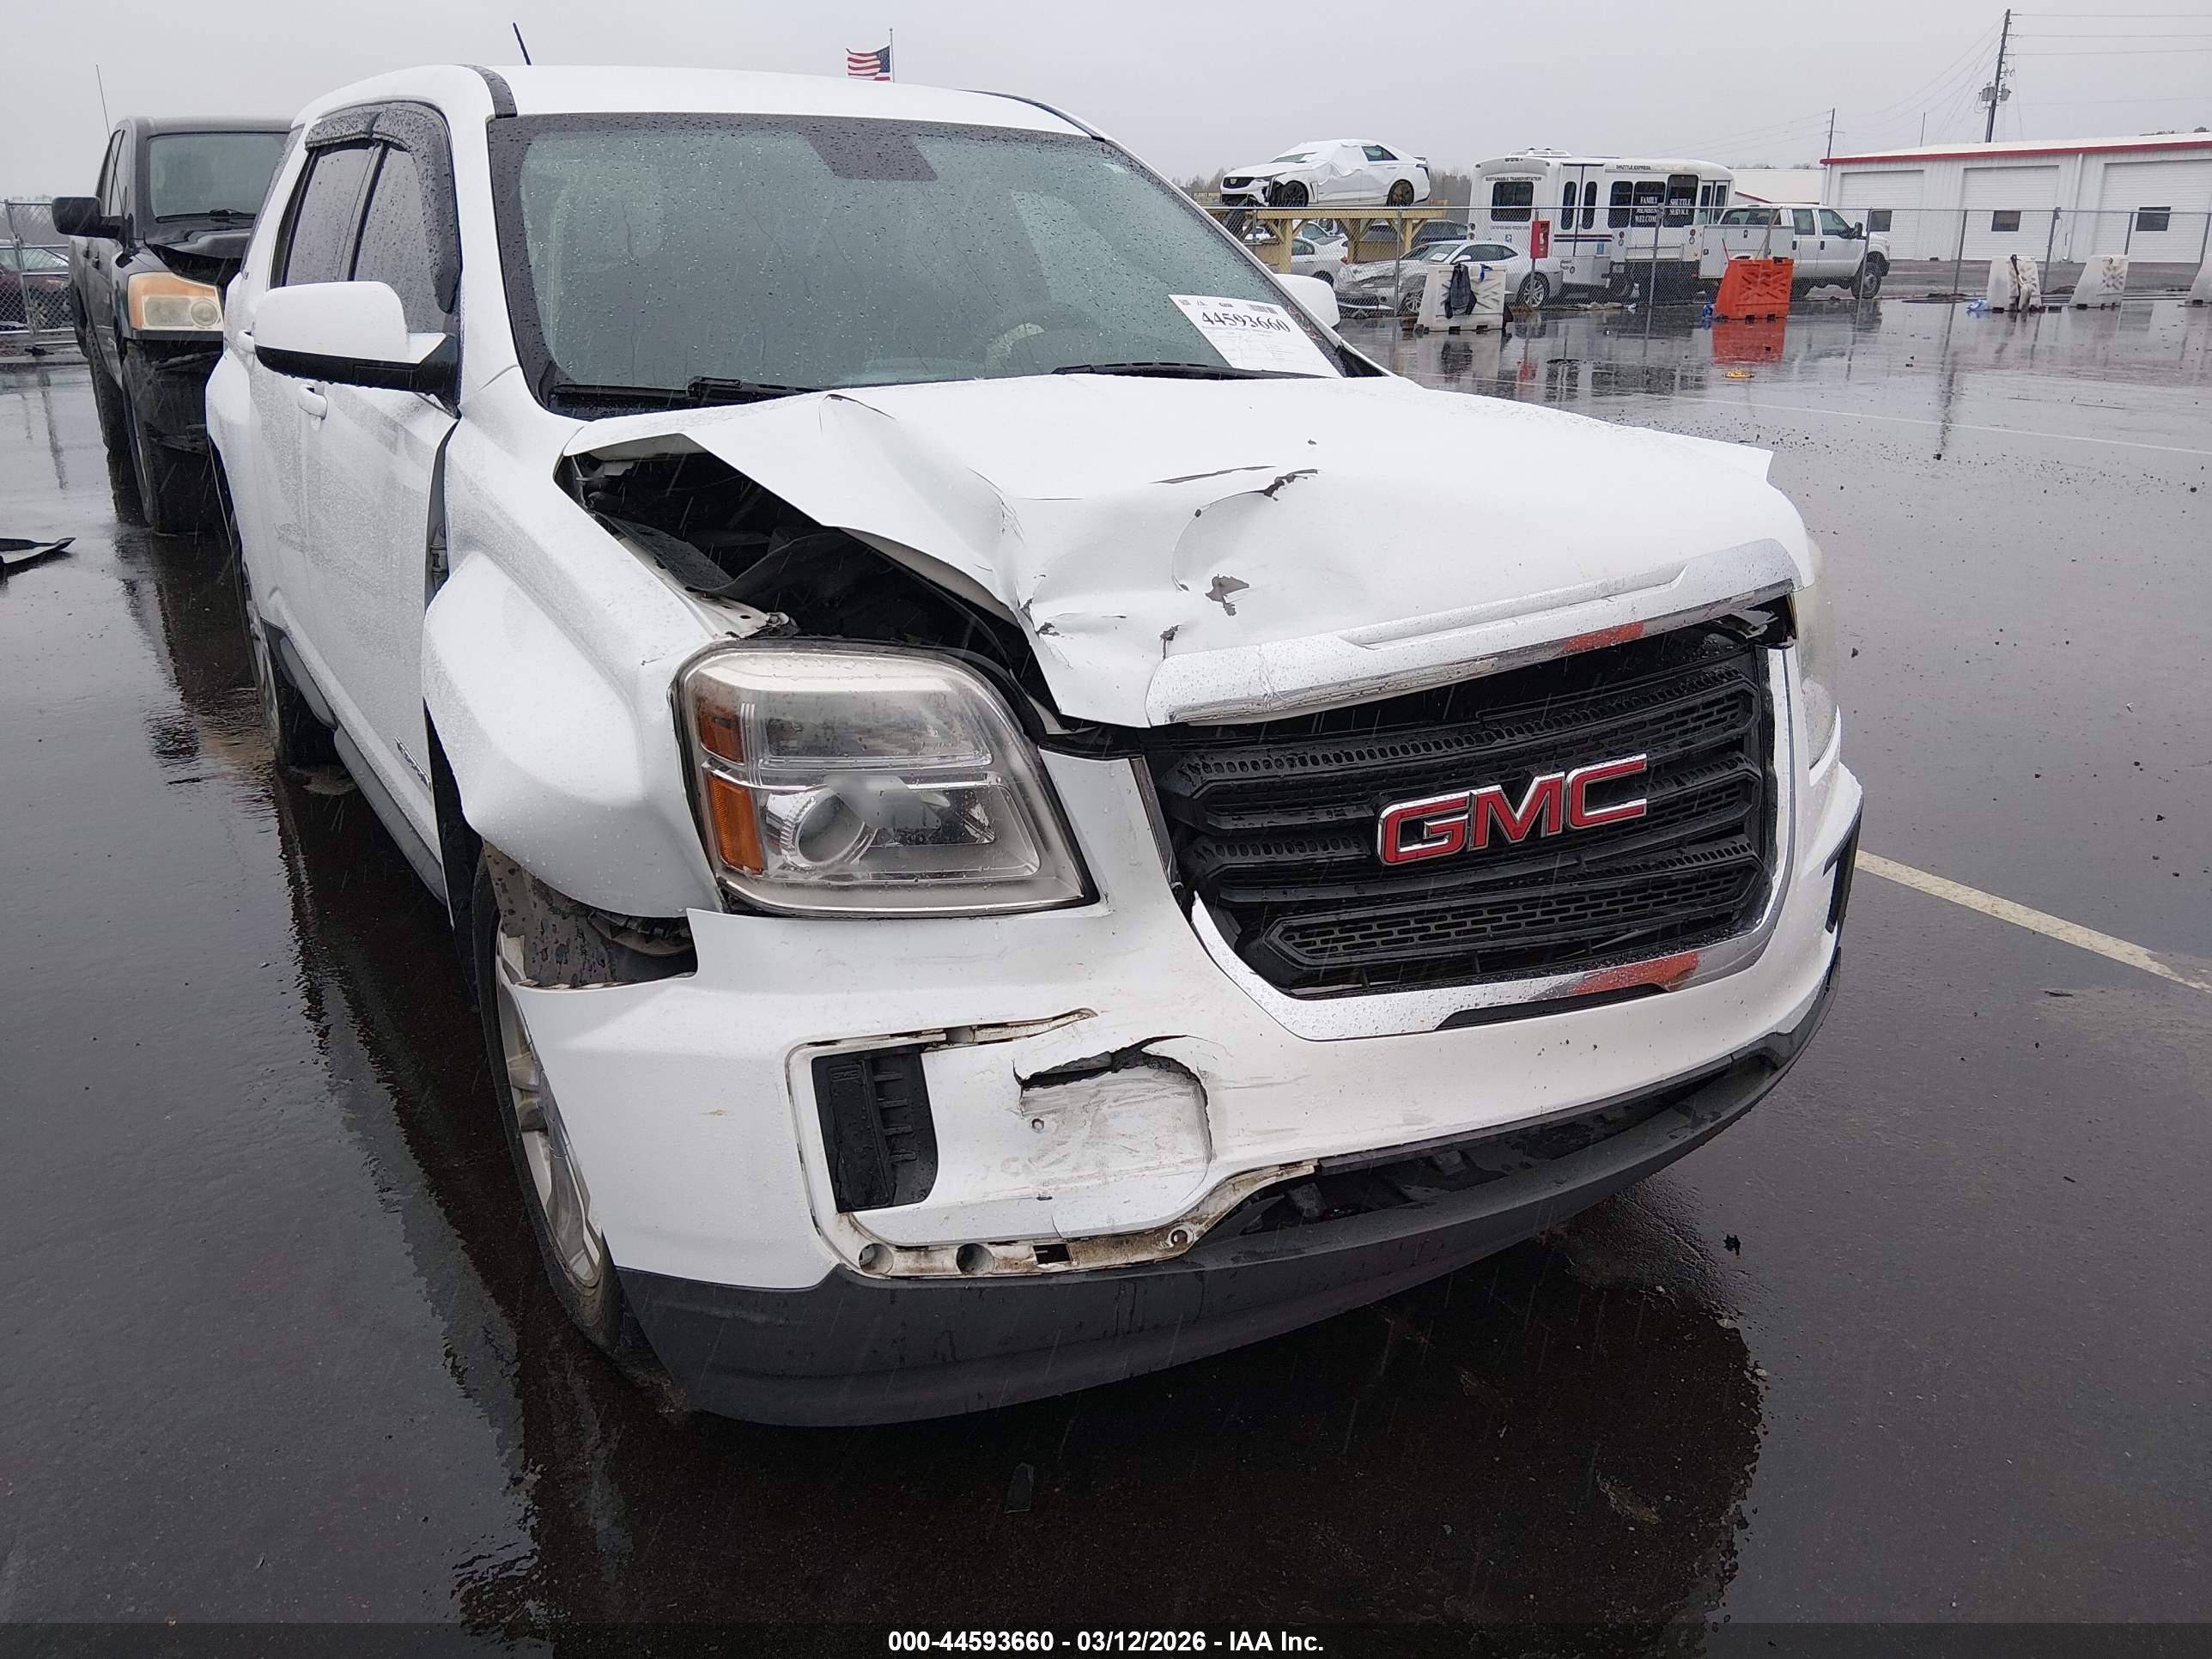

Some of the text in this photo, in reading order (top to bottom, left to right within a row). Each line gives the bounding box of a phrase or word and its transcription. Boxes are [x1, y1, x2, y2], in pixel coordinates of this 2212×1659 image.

[1640, 196, 1658, 204] FAMILY
[1201, 312, 1291, 332] 44593660
[1377, 752, 1647, 866] GMC
